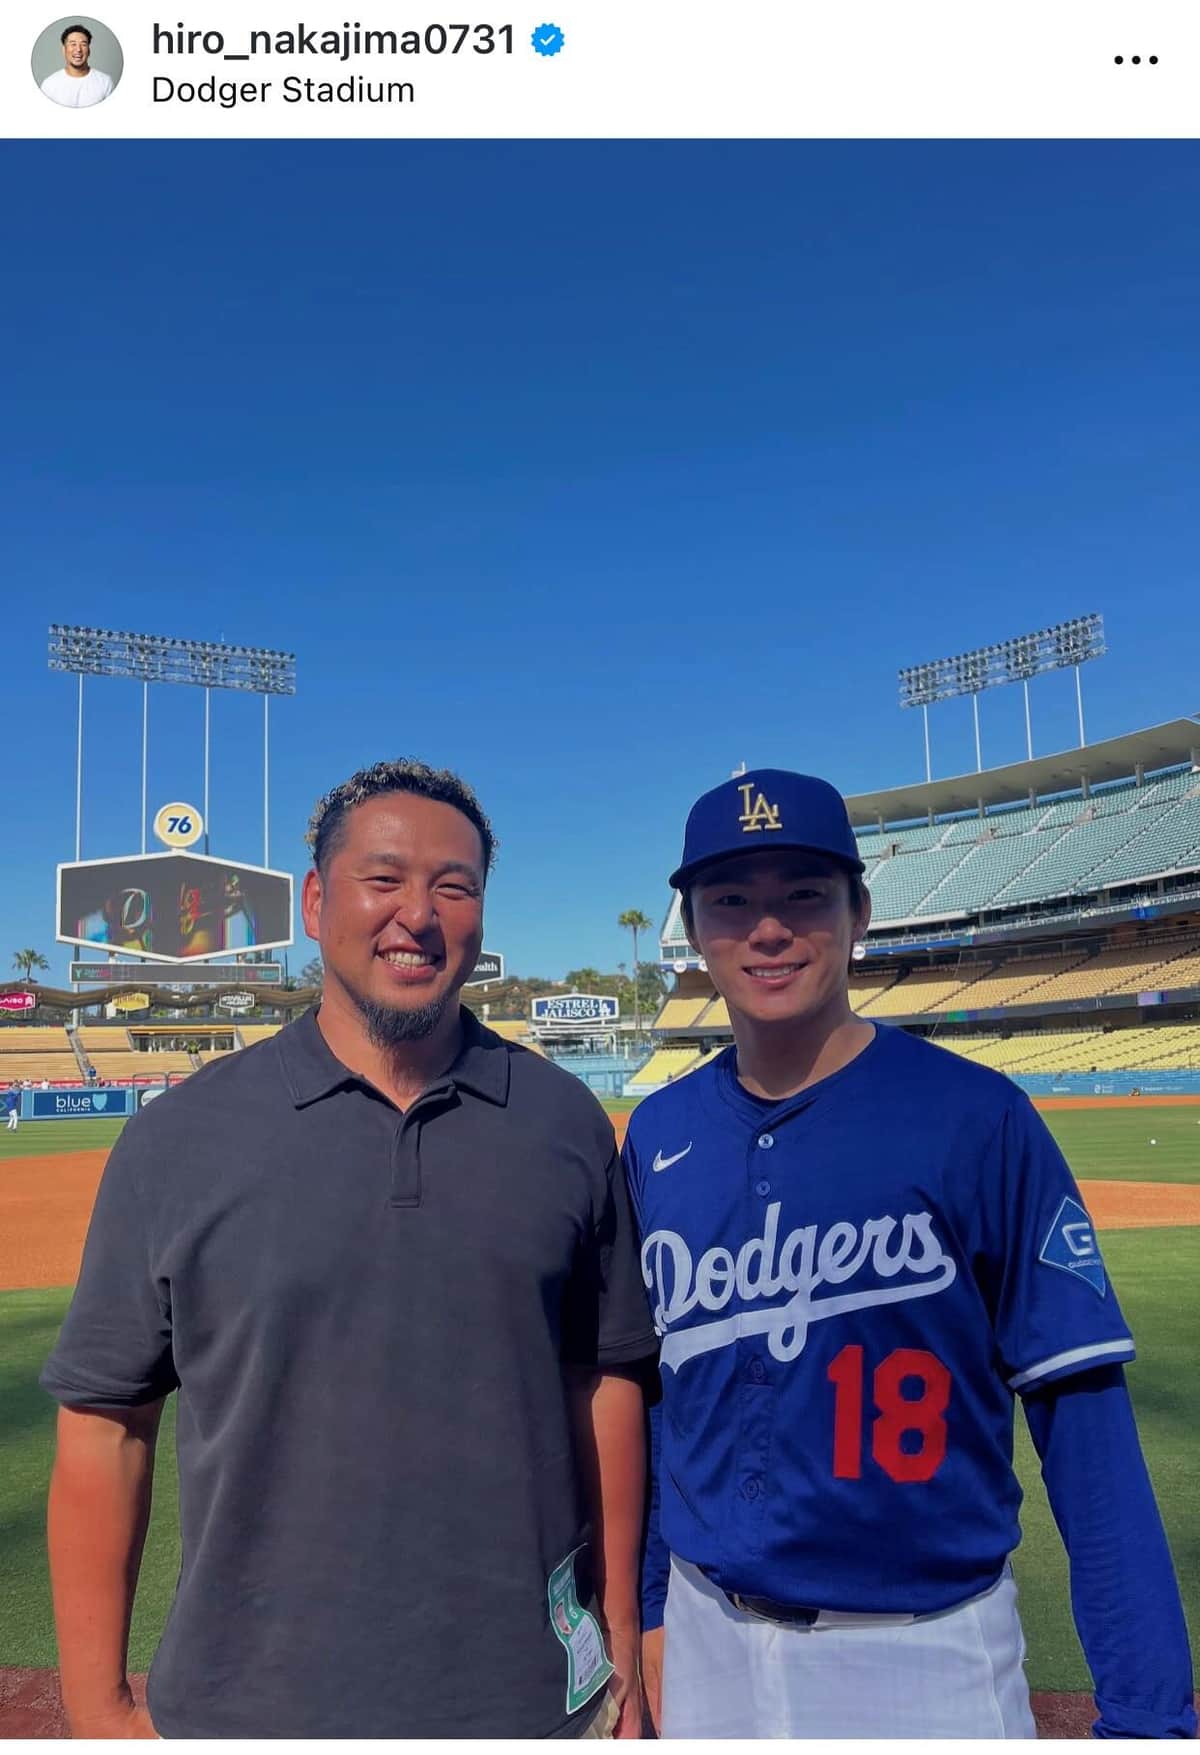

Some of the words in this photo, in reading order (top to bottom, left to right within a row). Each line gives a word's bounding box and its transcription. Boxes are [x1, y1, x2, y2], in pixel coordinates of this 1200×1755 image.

[738, 783, 782, 832] LA
[167, 816, 192, 835] 76
[474, 961, 498, 972] ealth
[541, 1008, 596, 1018] JALISCO
[56, 1095, 91, 1108] blue
[641, 1201, 956, 1366] Dodgers
[827, 1344, 952, 1484] 18
